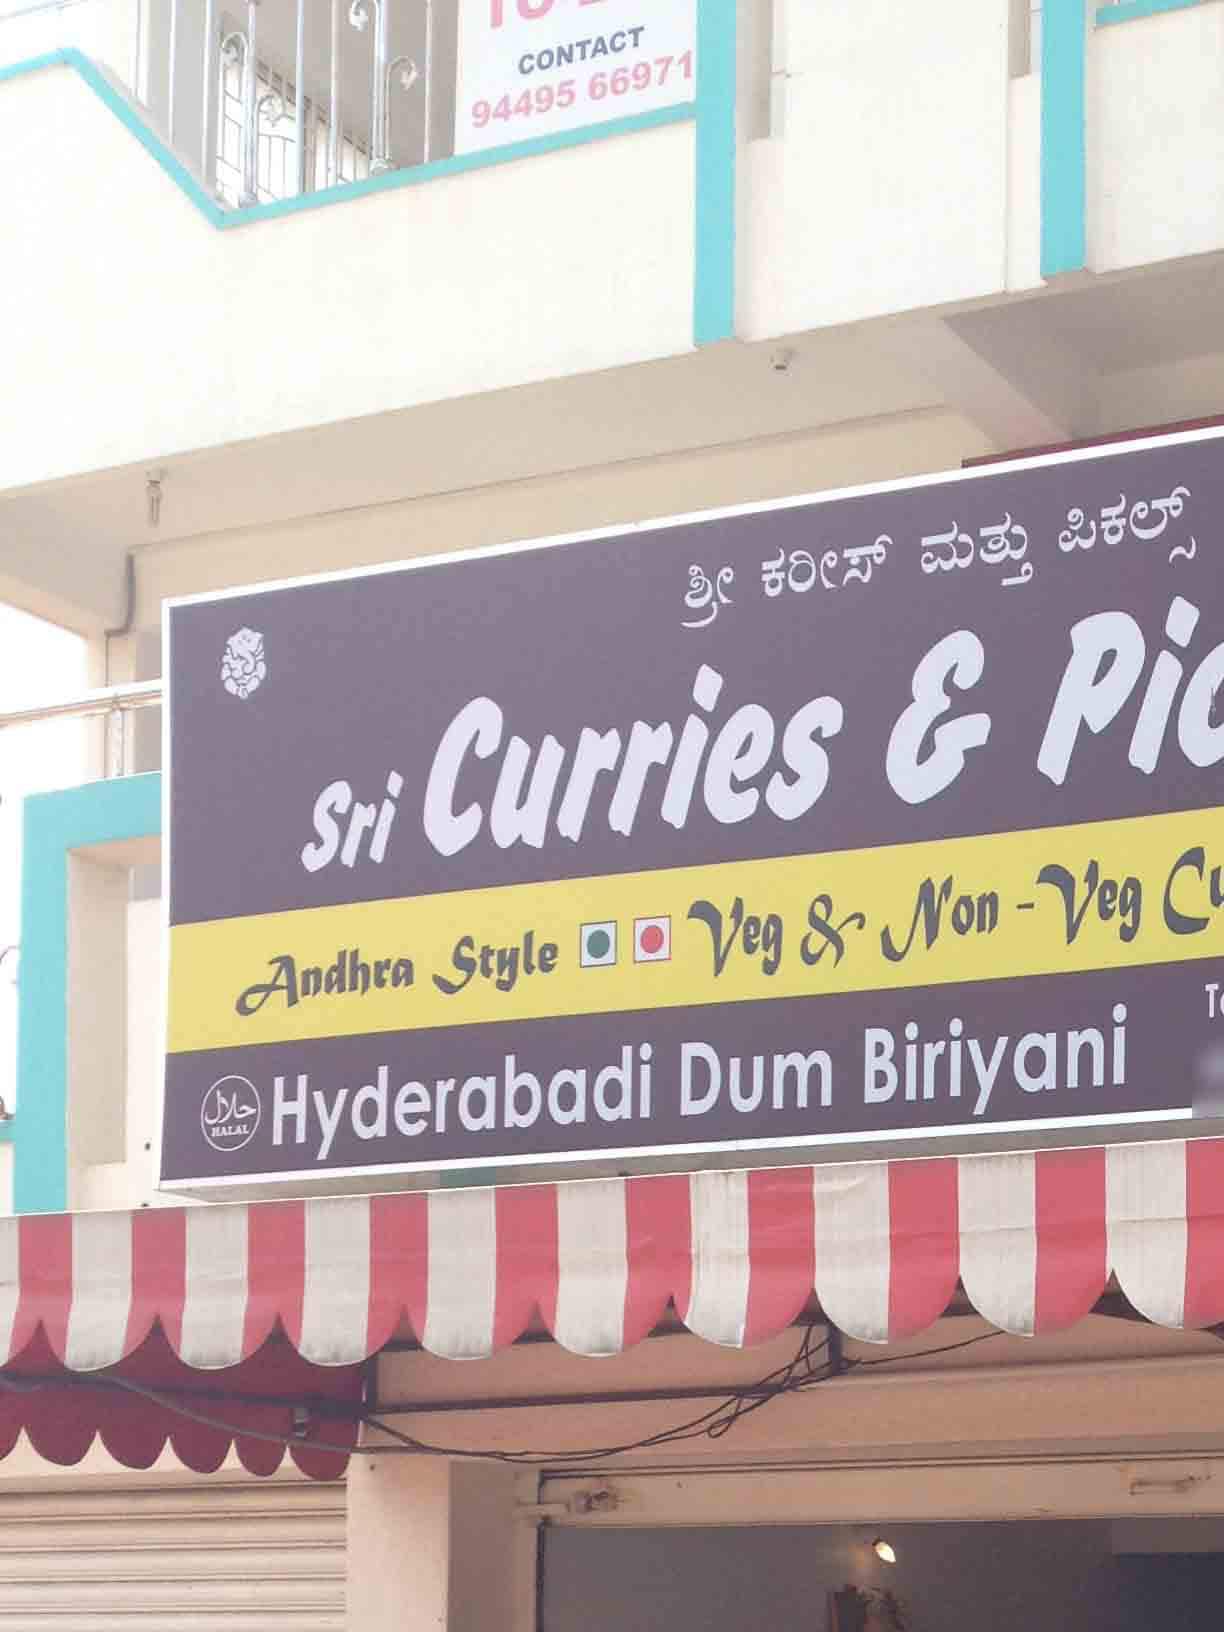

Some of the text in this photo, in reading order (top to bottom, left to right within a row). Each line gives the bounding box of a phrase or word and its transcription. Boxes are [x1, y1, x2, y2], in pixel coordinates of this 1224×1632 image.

[471, 50, 693, 129] 94495 66971
[517, 26, 645, 75] CONTACT
[681, 564, 735, 628] ಶ್ರೀ
[761, 533, 894, 598] ಕರೀಸ್
[920, 511, 1034, 587] ಮತ್ತು
[300, 770, 404, 873] Sri
[421, 663, 844, 858] Curries
[885, 629, 992, 805] &
[235, 948, 414, 1017] Andhra
[432, 930, 559, 995] Style
[687, 896, 783, 977] Veg
[799, 893, 866, 969] &
[204, 1088, 257, 1125] حلال
[211, 1124, 249, 1137] HALAL
[271, 1042, 653, 1161] Hyderabadi
[679, 1042, 833, 1116] Dum
[863, 1003, 1127, 1116] Biriyani
